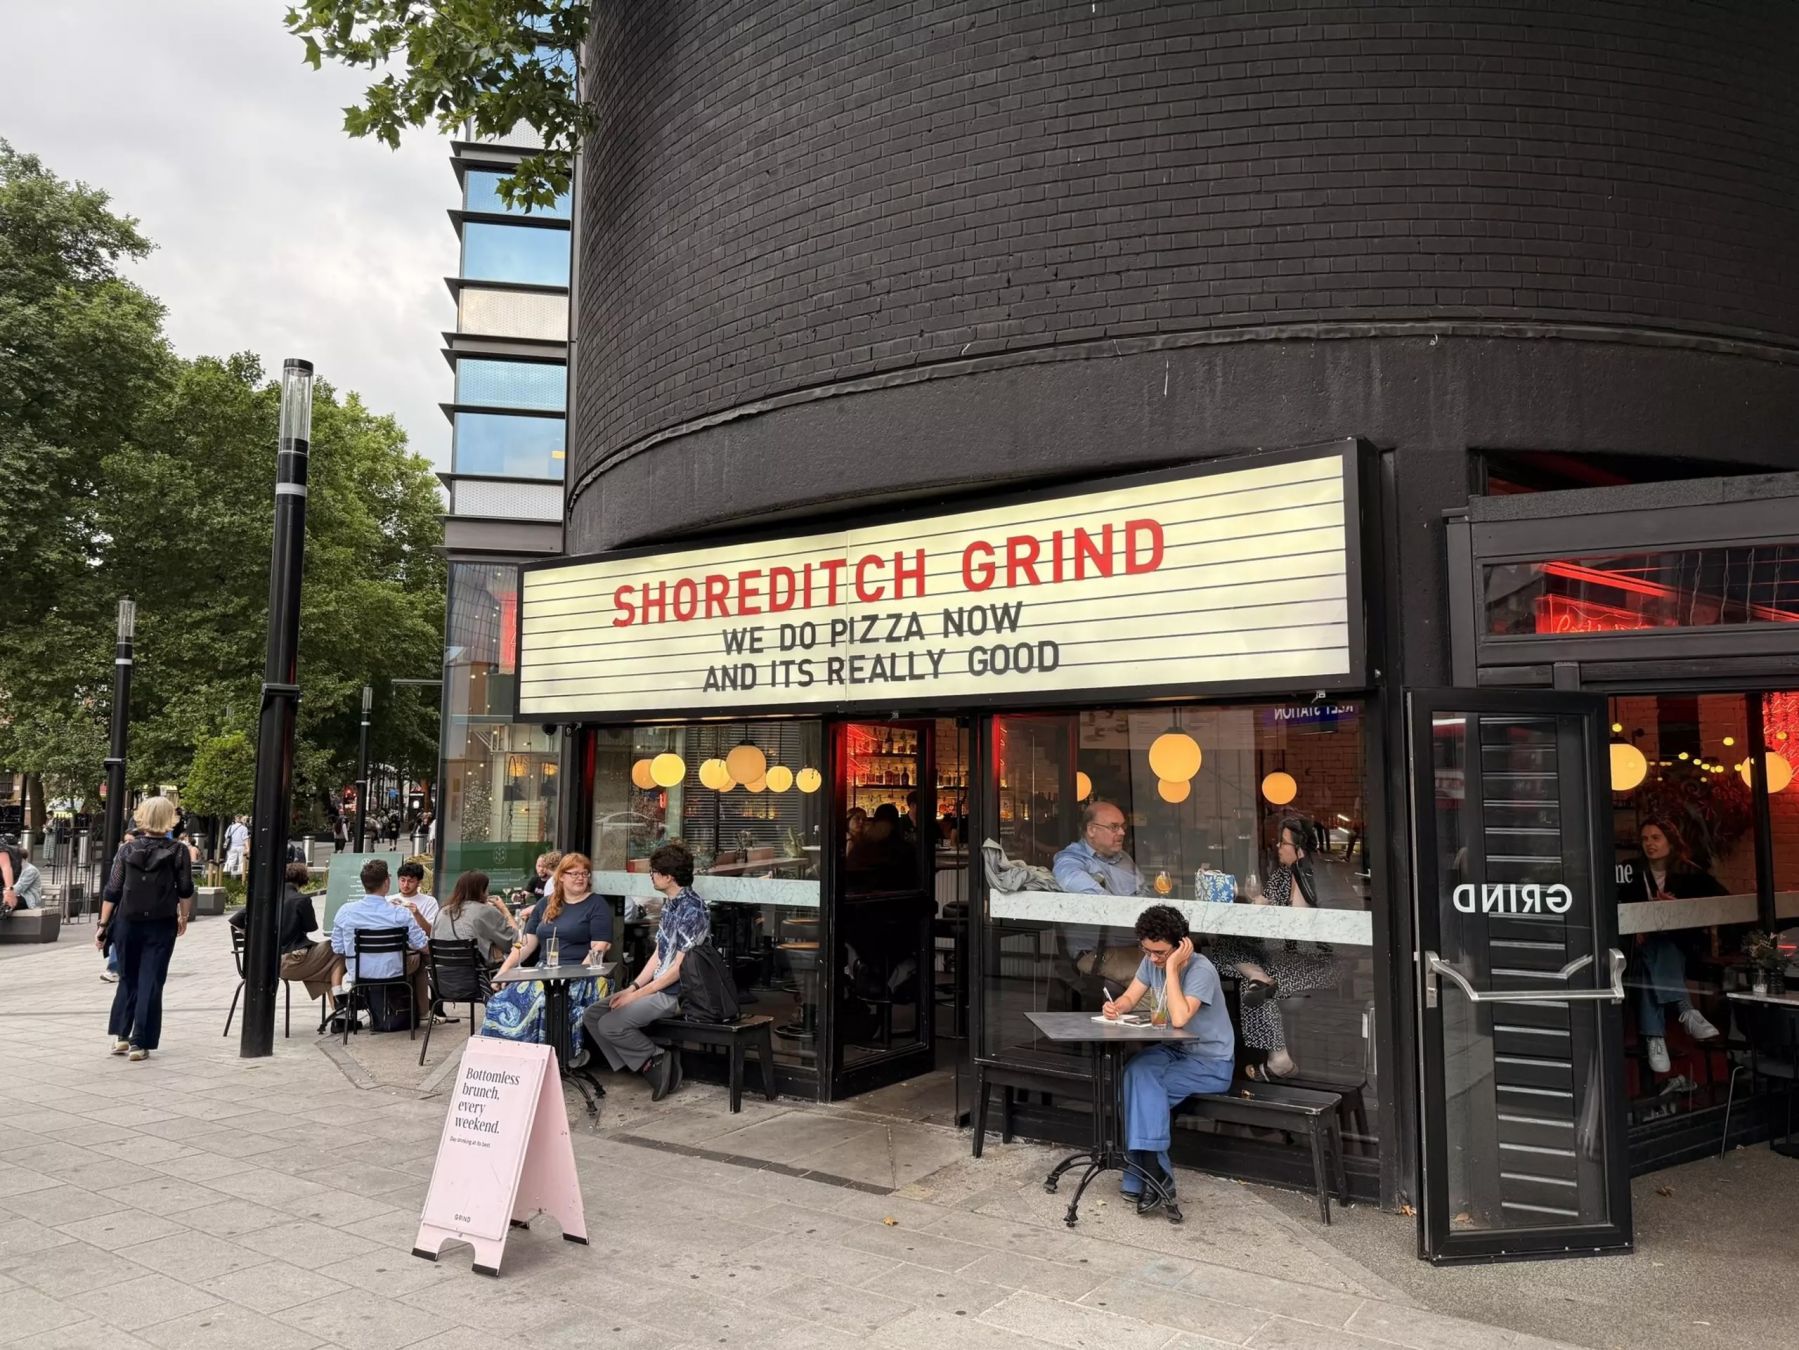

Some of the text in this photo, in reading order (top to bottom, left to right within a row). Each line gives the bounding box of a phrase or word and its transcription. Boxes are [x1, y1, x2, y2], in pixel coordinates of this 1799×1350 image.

[613, 518, 1165, 629] SHOREDITCH GRIND
[723, 602, 1024, 656] WE DO PIZZA NOW
[702, 640, 1061, 693] AND ITS REALLY GOOD
[466, 1067, 520, 1086] Bottomless
[455, 1117, 500, 1134] weekend.
[458, 1101, 486, 1117] every
